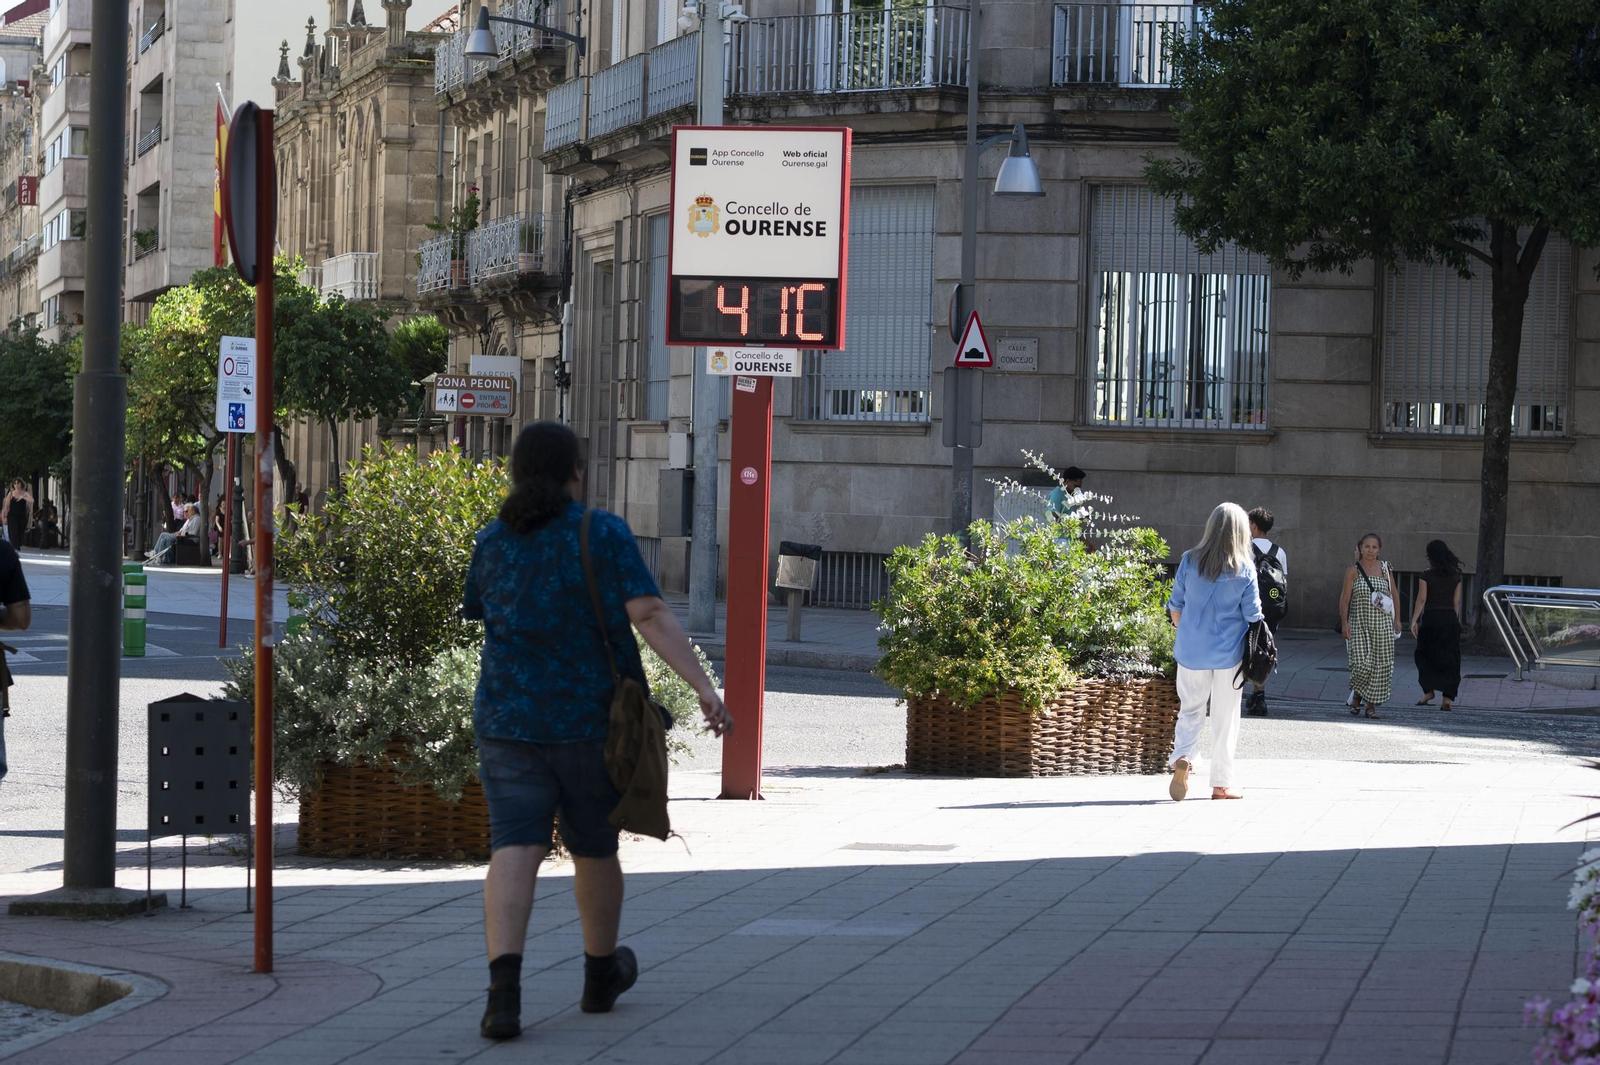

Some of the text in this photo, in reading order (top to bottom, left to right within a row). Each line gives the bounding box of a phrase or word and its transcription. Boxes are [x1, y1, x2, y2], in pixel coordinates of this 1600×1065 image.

[712, 149, 764, 158] App Concello
[782, 160, 828, 168] Ourense.gal
[725, 201, 811, 216] Concello de
[725, 219, 826, 237] OURENSE
[734, 350, 784, 360] Concello de
[1000, 356, 1034, 364] CONCEJO
[734, 361, 792, 373] OURENSE
[437, 377, 510, 389] ZONA PEONIL
